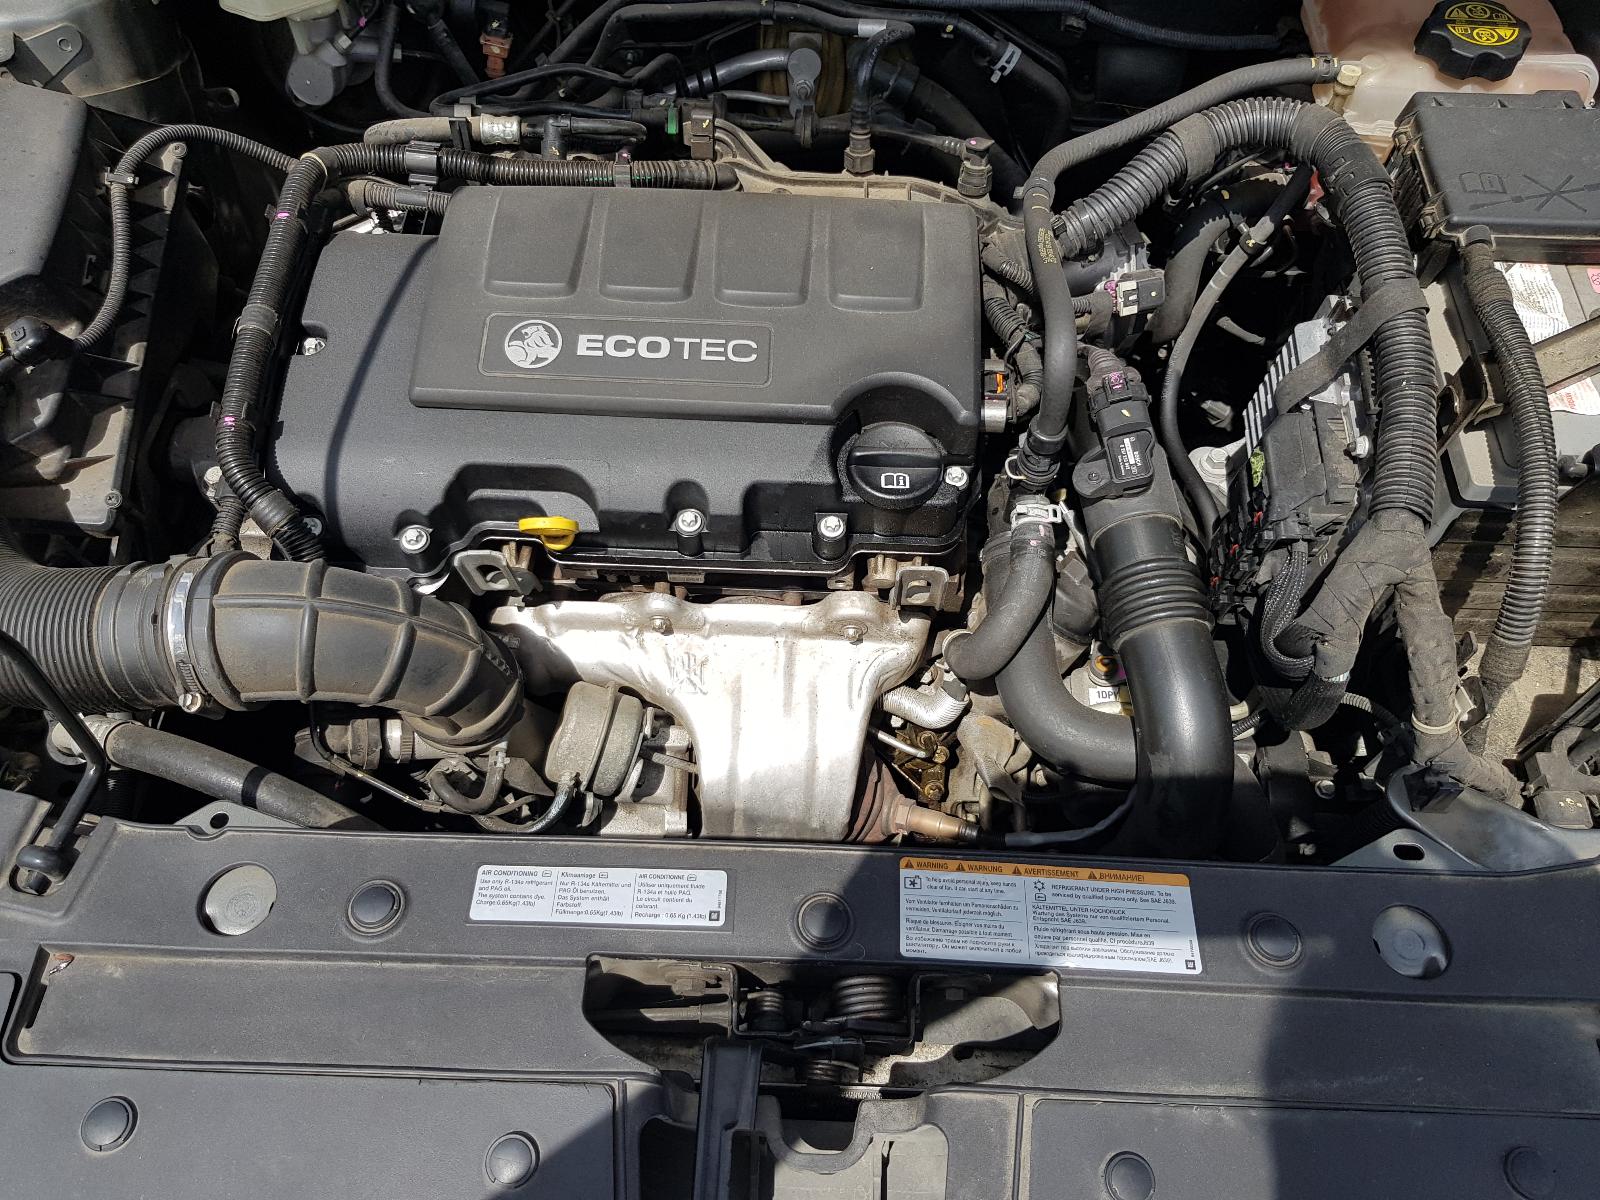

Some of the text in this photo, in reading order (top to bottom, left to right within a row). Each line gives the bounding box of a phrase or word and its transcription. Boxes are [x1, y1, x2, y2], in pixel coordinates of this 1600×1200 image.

[577, 334, 757, 362] ECOTEC
[917, 862, 1079, 878] WARNING WARNUNG AVERTISSEMENT
[1099, 873, 1144, 882] ВНИМАНИЕ!
[1051, 884, 1090, 892] REFRIGERANT
[1091, 886, 1110, 894] UNDER
